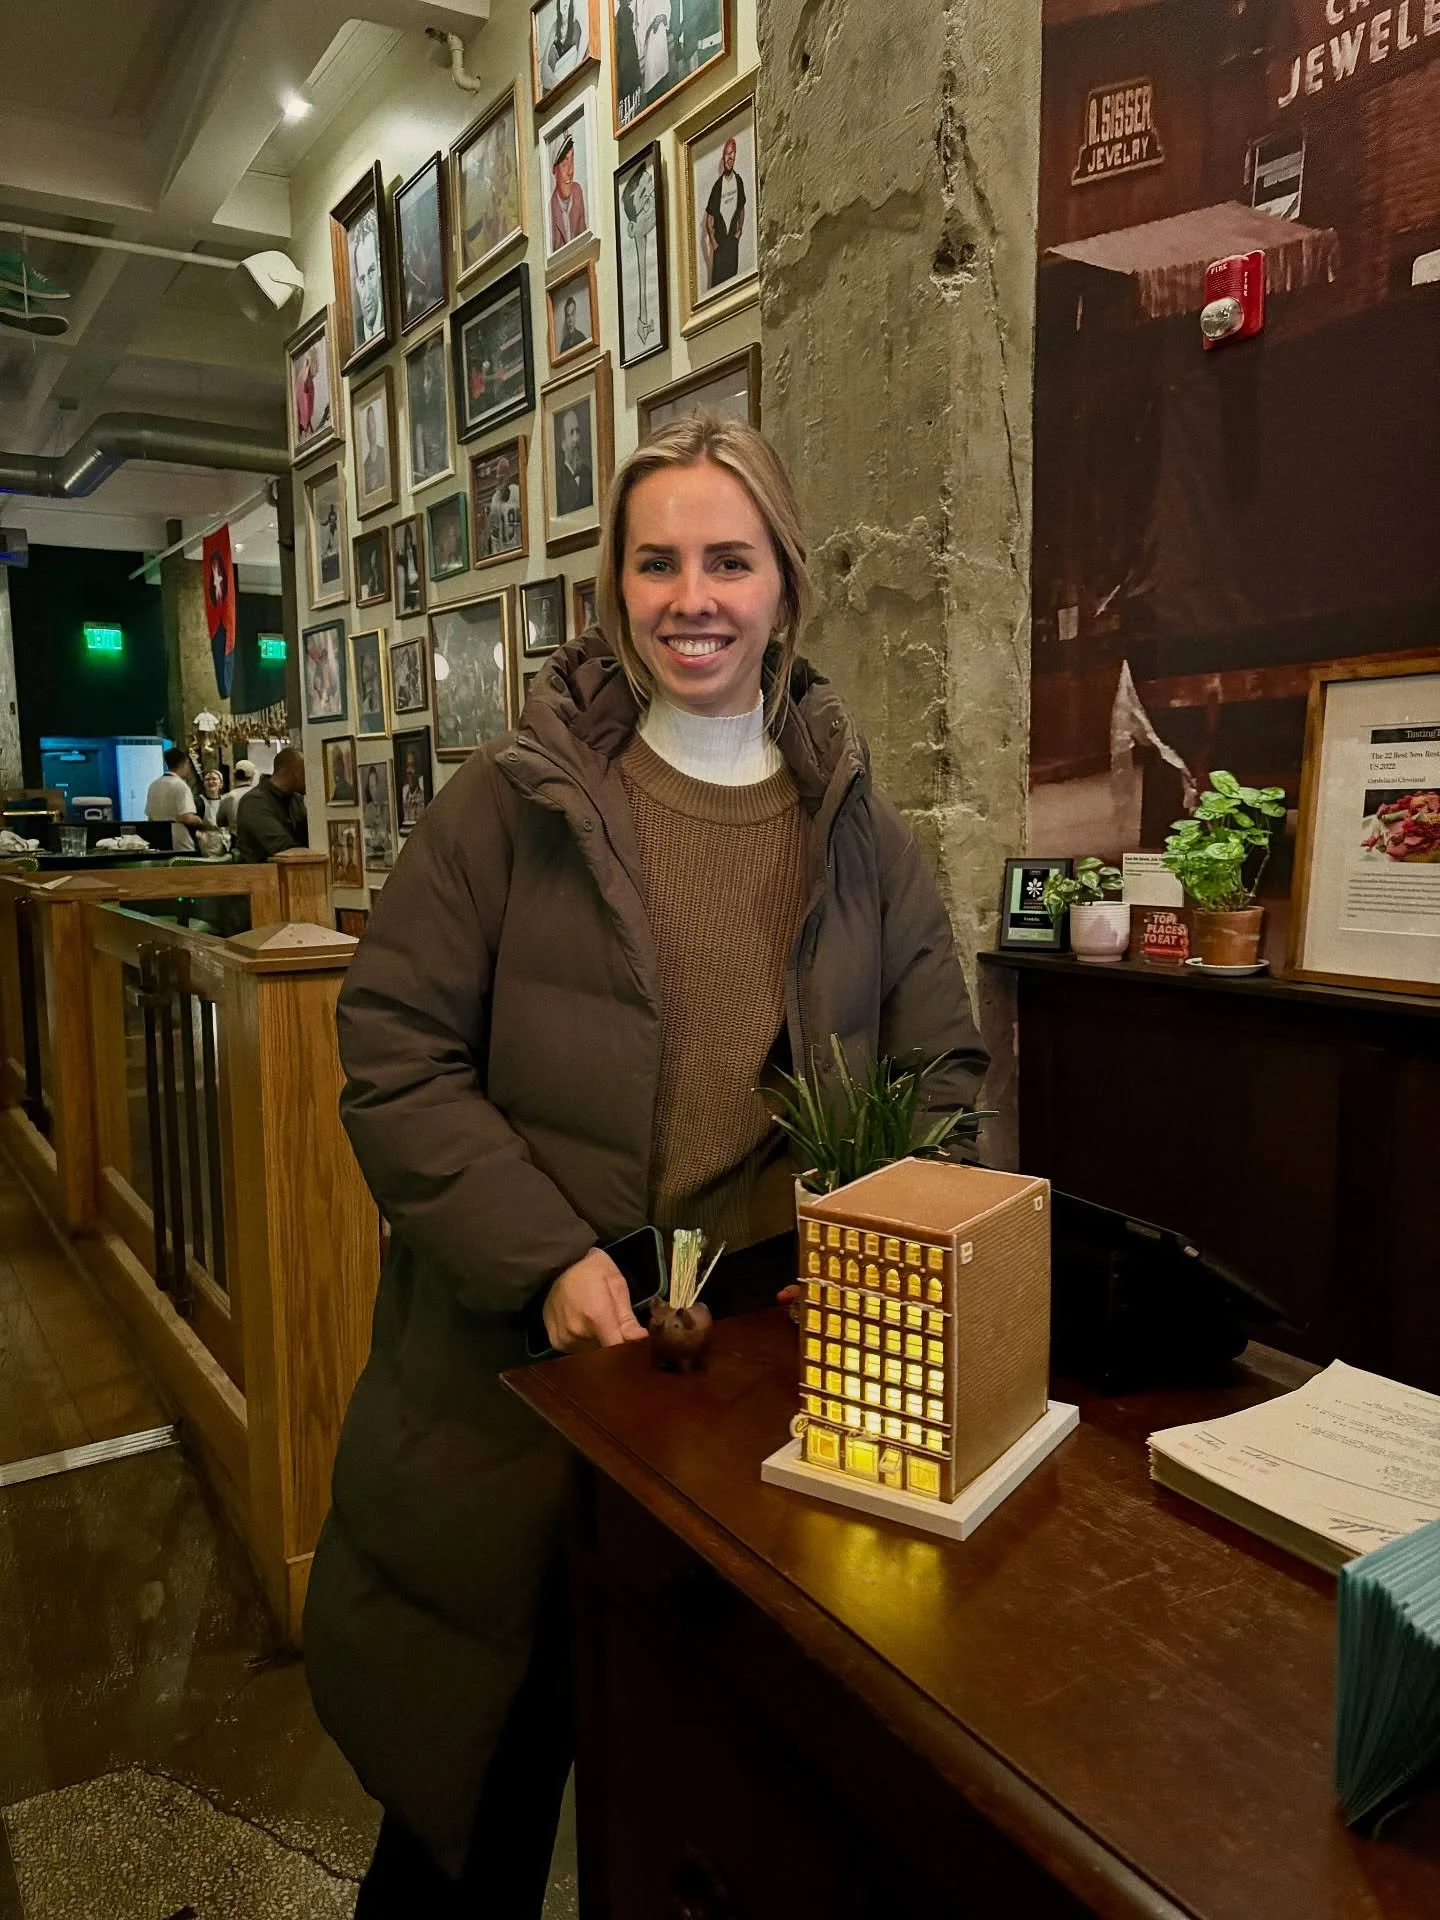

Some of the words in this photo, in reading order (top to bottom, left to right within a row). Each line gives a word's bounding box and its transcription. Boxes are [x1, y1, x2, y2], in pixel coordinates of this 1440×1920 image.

[1210, 262, 1228, 275] FIRE
[1393, 751, 1408, 759] Best
[1153, 914, 1173, 925] TOP
[1146, 923, 1184, 936] PLACES
[1143, 933, 1157, 943] TO
[1157, 934, 1178, 945] EAT
